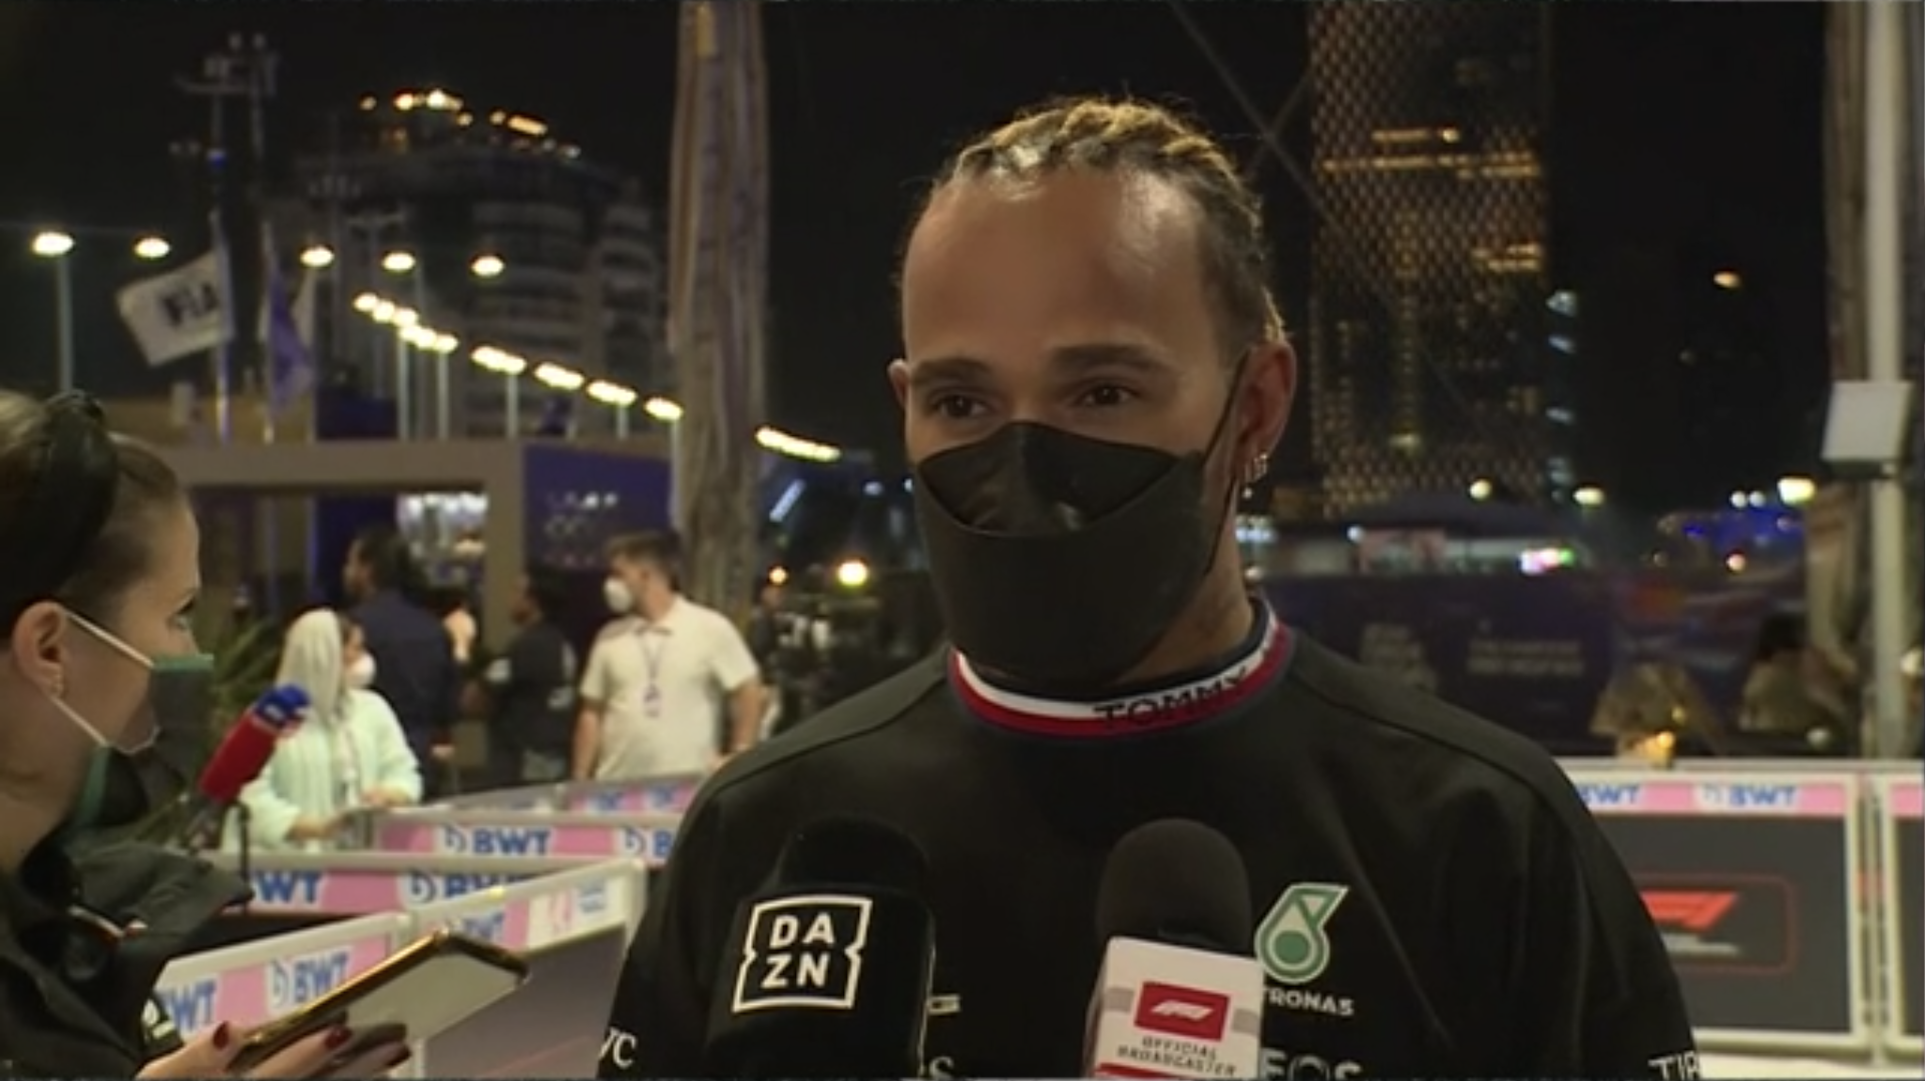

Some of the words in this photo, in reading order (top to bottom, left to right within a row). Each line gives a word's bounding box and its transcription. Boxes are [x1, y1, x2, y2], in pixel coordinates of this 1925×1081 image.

[1093, 666, 1247, 727] TOMMY
[473, 828, 550, 855] BWT
[253, 870, 321, 904] WT
[1264, 986, 1355, 1016] RONAS
[1117, 1045, 1237, 1077] BROADCASTER
[1142, 1037, 1217, 1061] OFFICIAL
